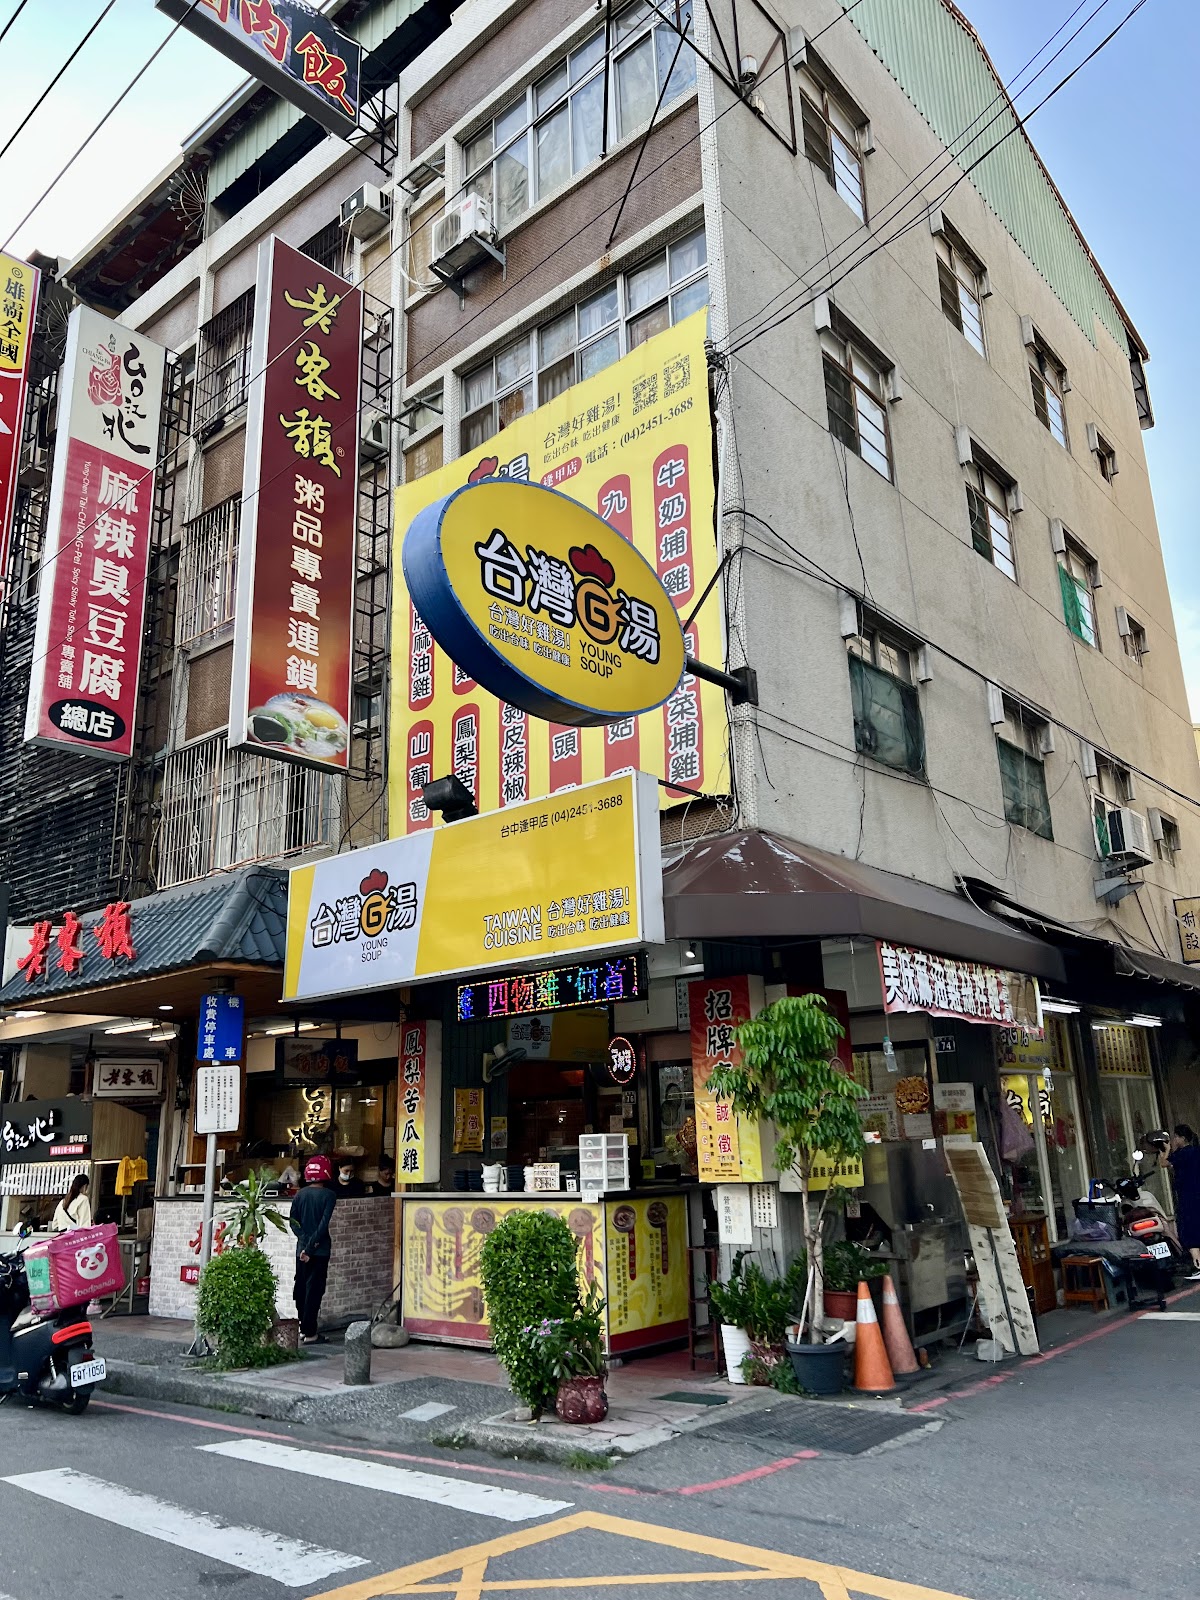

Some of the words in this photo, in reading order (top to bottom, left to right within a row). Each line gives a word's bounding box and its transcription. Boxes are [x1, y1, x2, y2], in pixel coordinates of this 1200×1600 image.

[203, 0, 355, 116] 肉飯
[543, 438, 579, 464] 吃出台味
[583, 414, 621, 442] 吃出健康
[79, 465, 140, 701] 麻辣臭豆腐
[285, 474, 325, 695] 粥品專賣連鎖
[488, 602, 571, 650] 台灣好雞湯!
[489, 624, 530, 651] 吃出台味
[533, 641, 571, 668] 吃出健康
[579, 640, 622, 669] YOUNG
[580, 656, 613, 679] SOUP
[60, 703, 115, 738] 總店
[500, 814, 549, 839] 台中逢甲店
[551, 794, 624, 828] (04)2451-3688
[483, 905, 542, 932] TAIWAN
[546, 887, 630, 922] 台灣好雞湯!
[483, 923, 543, 950] CUISINE
[547, 919, 586, 939] 吃出台味
[589, 911, 630, 931] 吃出健康
[361, 938, 388, 951] YOUNG
[361, 950, 382, 963] SOUP
[203, 996, 218, 1060] 收費停車處
[401, 1028, 424, 1174] 鳳梨苦瓜雞
[29, 1268, 43, 1279] Uber
[74, 1278, 116, 1298] foodpanda
